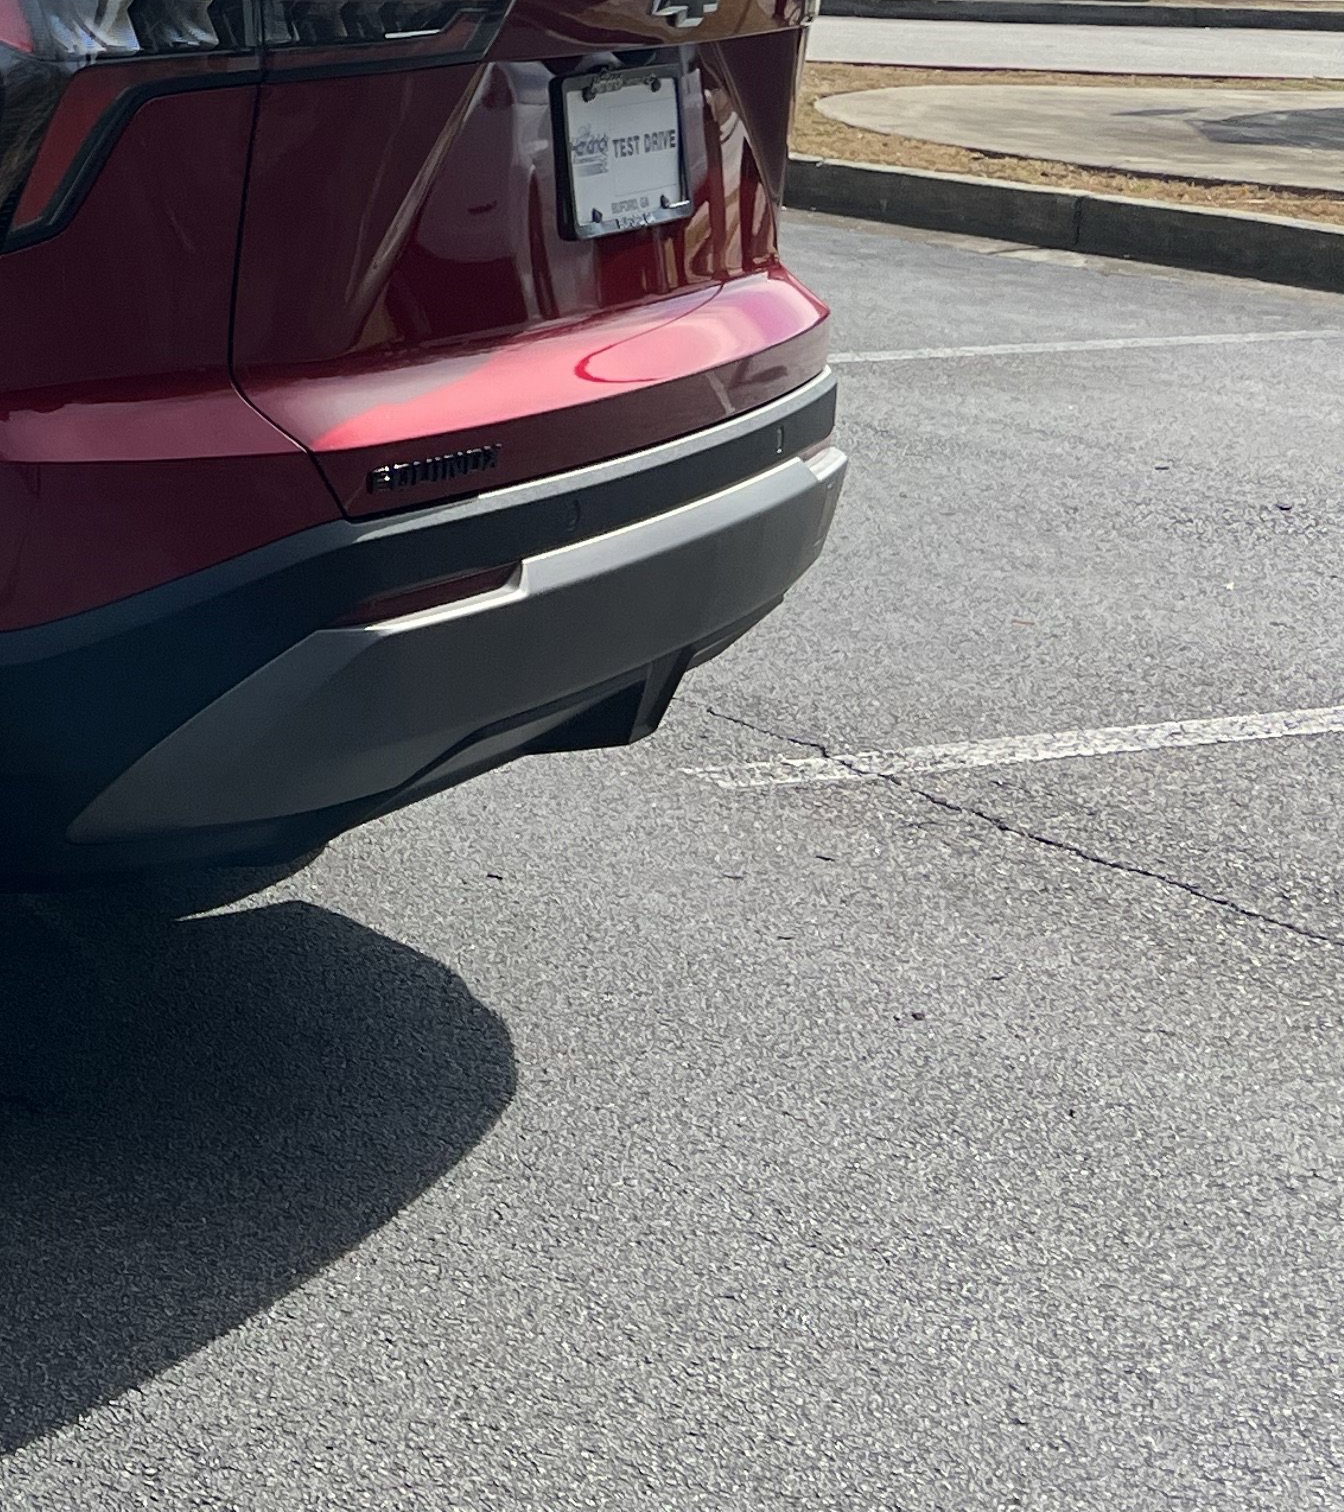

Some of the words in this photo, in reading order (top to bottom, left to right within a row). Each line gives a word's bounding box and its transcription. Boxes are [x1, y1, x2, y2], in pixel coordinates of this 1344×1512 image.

[612, 135, 640, 159] TEST
[643, 129, 676, 154] DRIVE
[366, 443, 502, 495] EQUINOX
